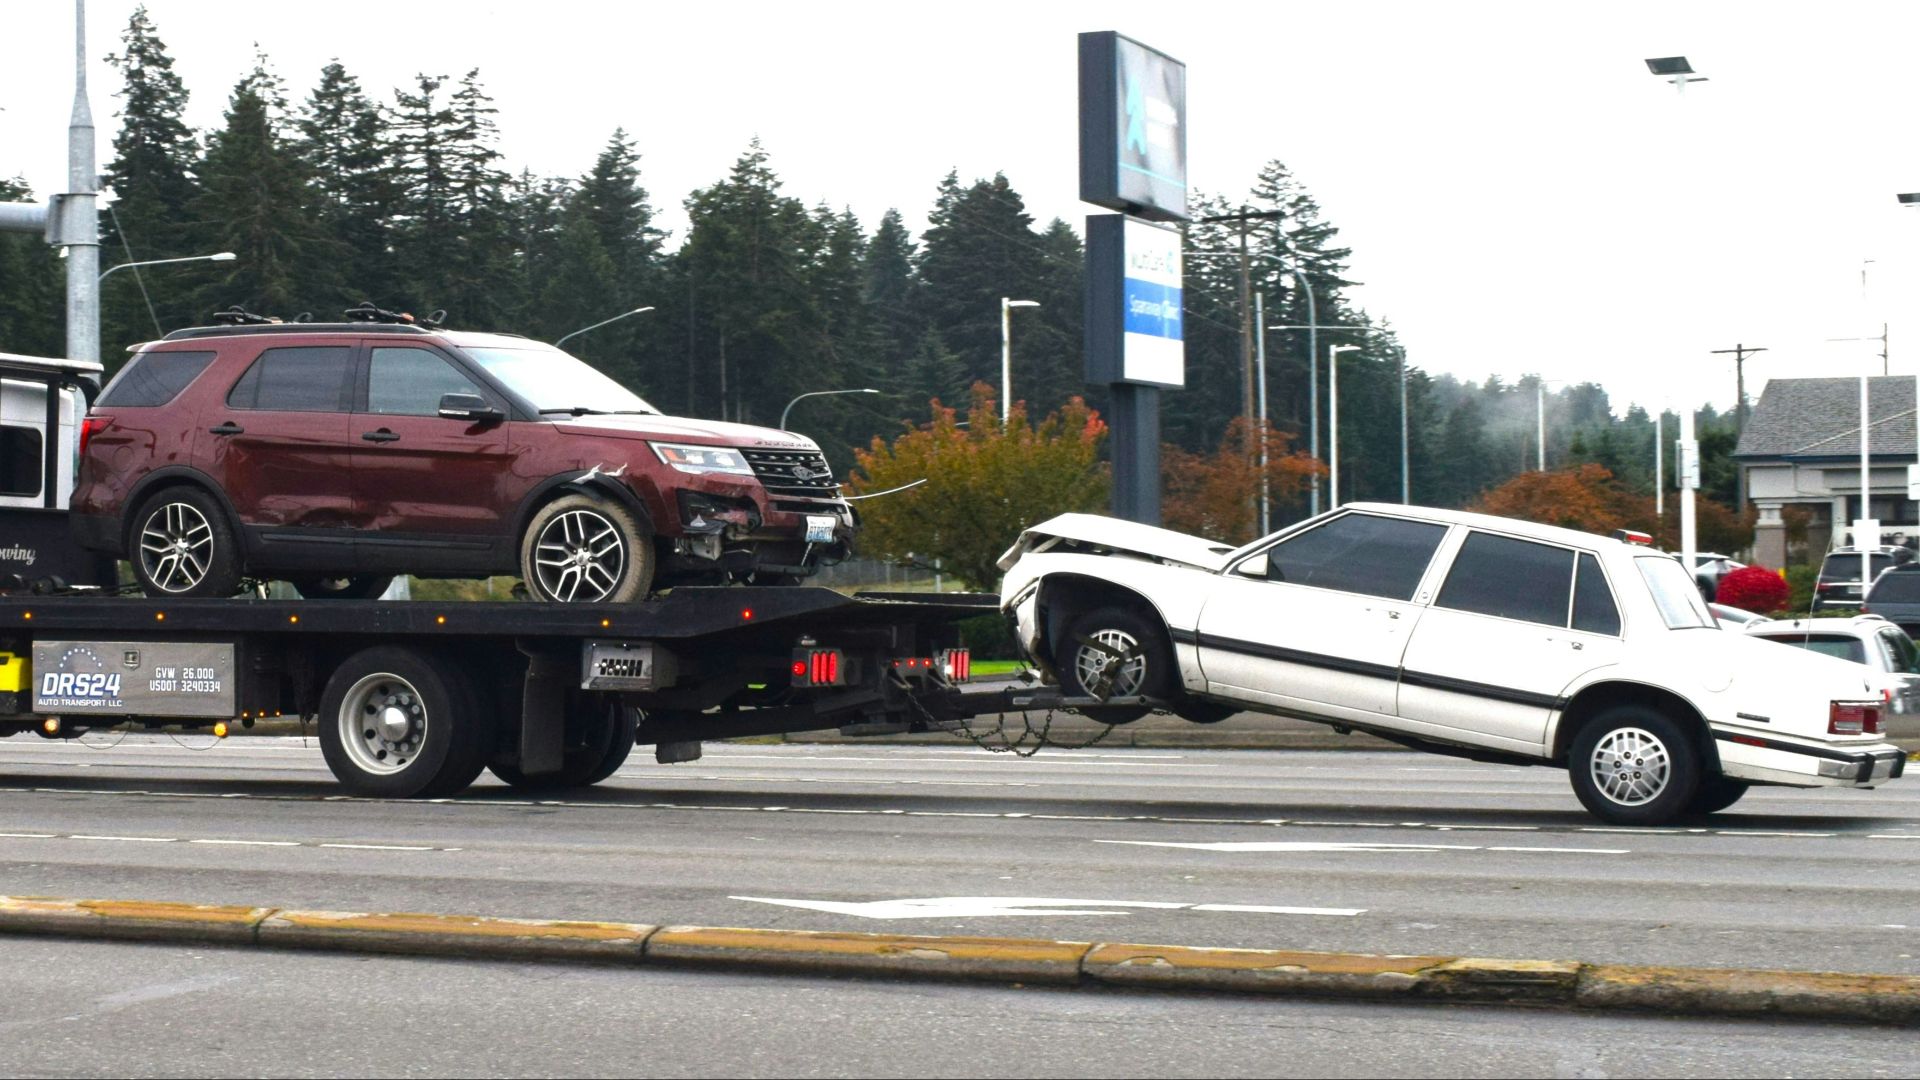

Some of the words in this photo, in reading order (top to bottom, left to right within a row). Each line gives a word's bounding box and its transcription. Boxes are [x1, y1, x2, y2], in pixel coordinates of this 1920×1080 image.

[155, 667, 175, 679] GVW
[41, 672, 121, 697] DRS24
[181, 681, 221, 693] 3240334
[61, 699, 106, 707] TRANSPORT
